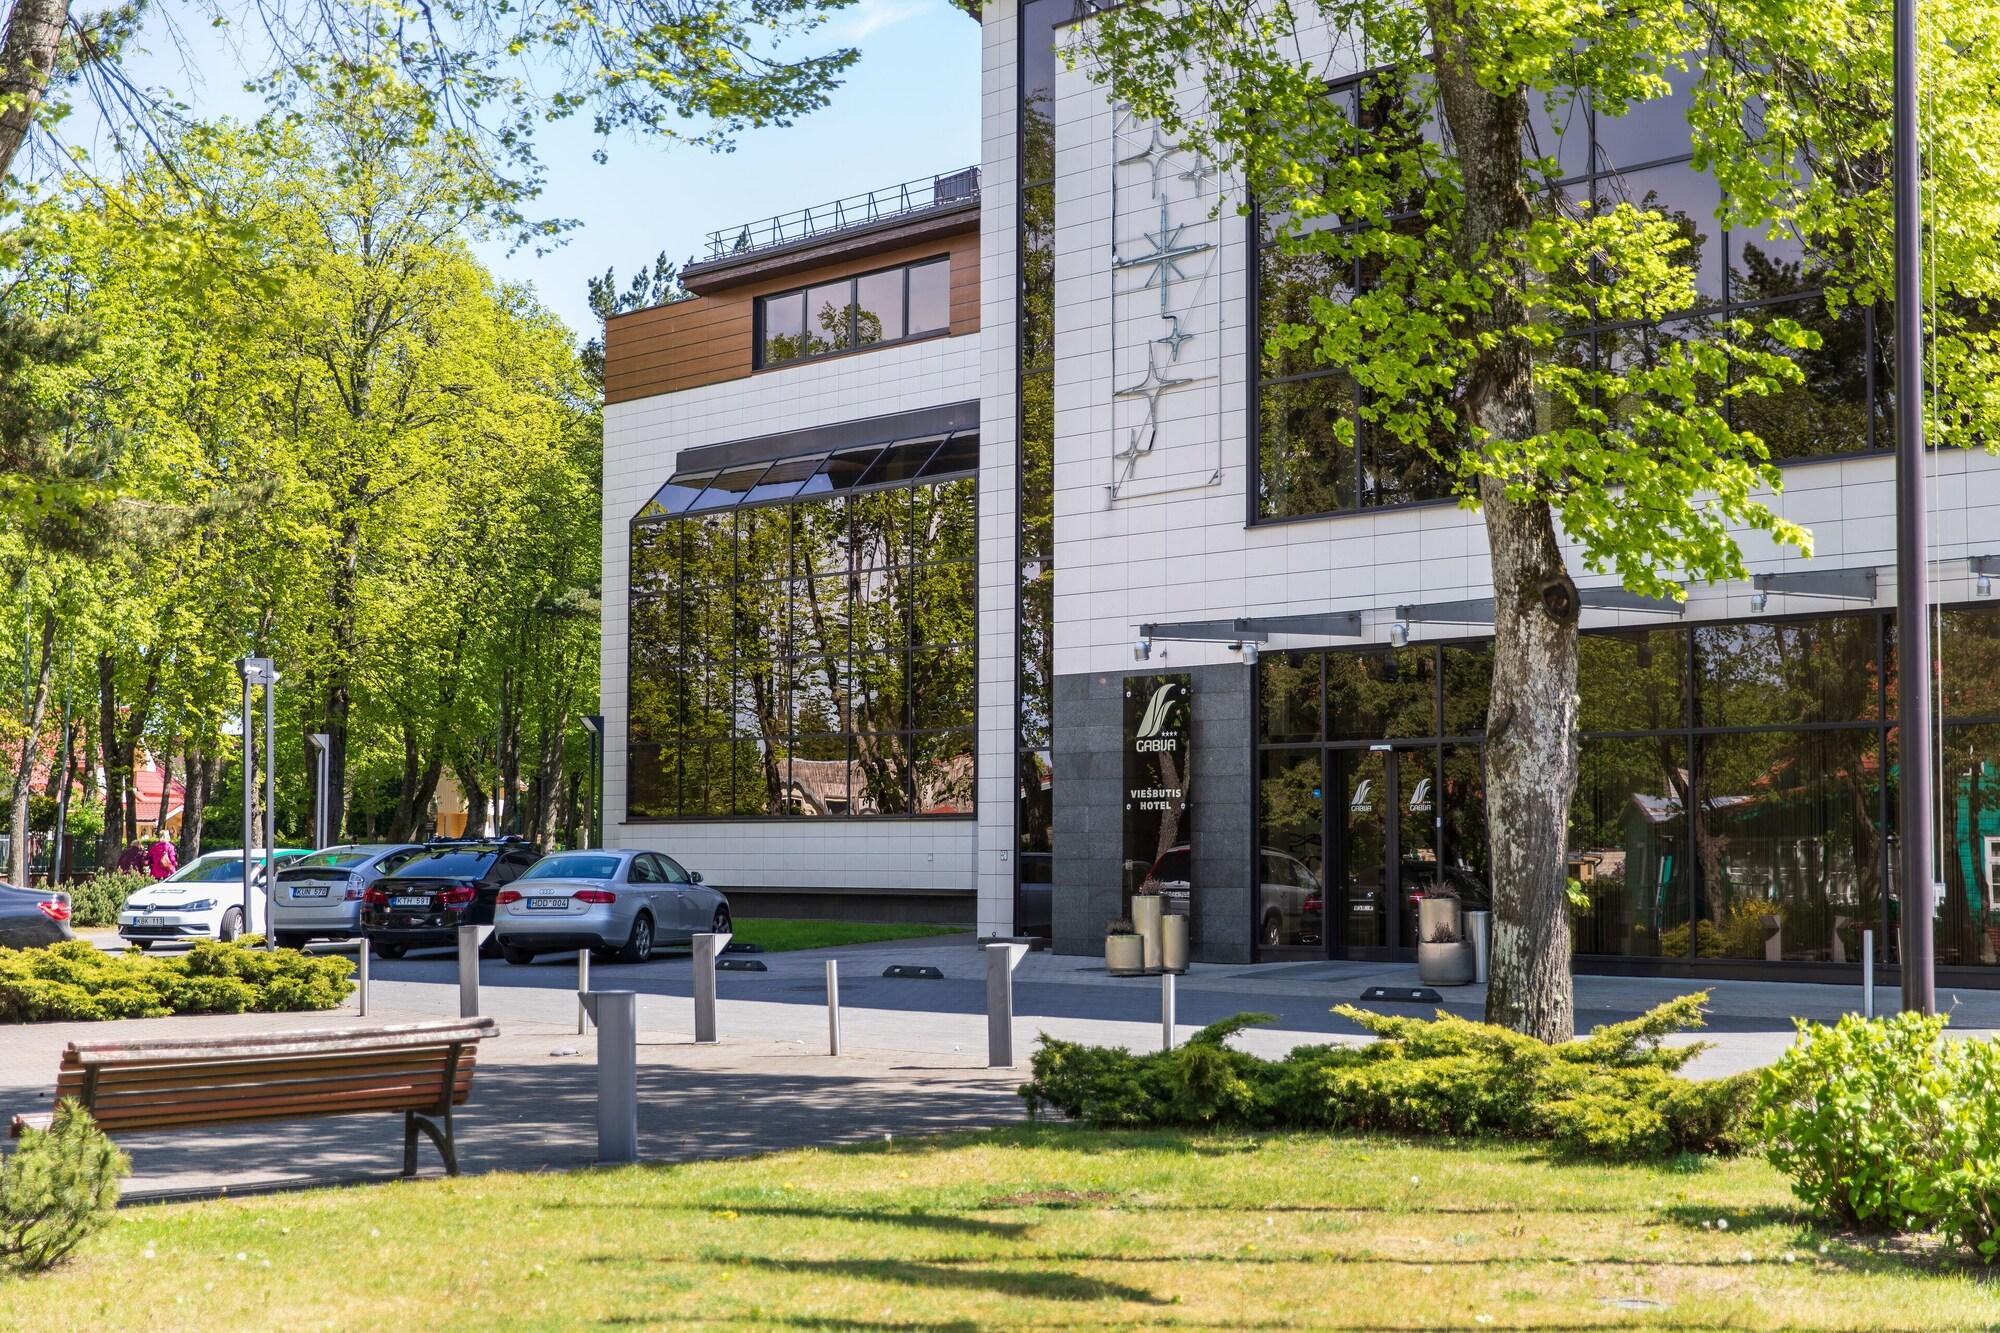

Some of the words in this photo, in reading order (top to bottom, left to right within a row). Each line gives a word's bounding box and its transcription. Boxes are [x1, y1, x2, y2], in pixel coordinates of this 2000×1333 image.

[1130, 788, 1181, 798] VIEŠBUTIS
[1140, 801, 1171, 810] HOTEL
[397, 896, 412, 905] KTH
[416, 896, 430, 905] 591
[532, 898, 549, 907] HDD
[552, 898, 566, 907] 004
